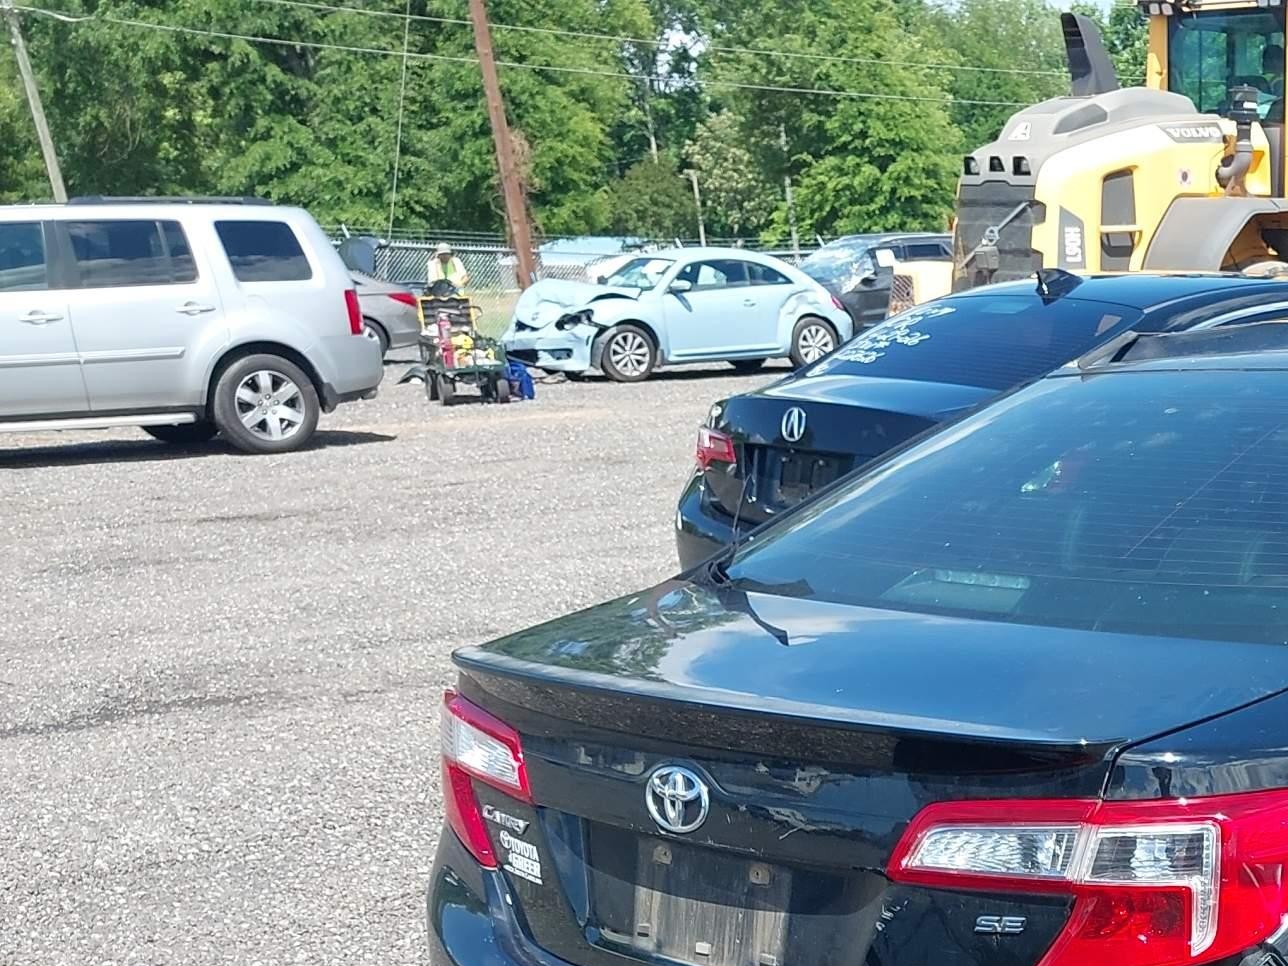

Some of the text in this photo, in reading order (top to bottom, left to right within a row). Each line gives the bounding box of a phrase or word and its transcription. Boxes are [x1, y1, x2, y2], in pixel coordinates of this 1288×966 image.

[1165, 127, 1221, 138] VOLVO
[511, 836, 540, 862] TOYOTA
[974, 915, 1027, 934] SE
